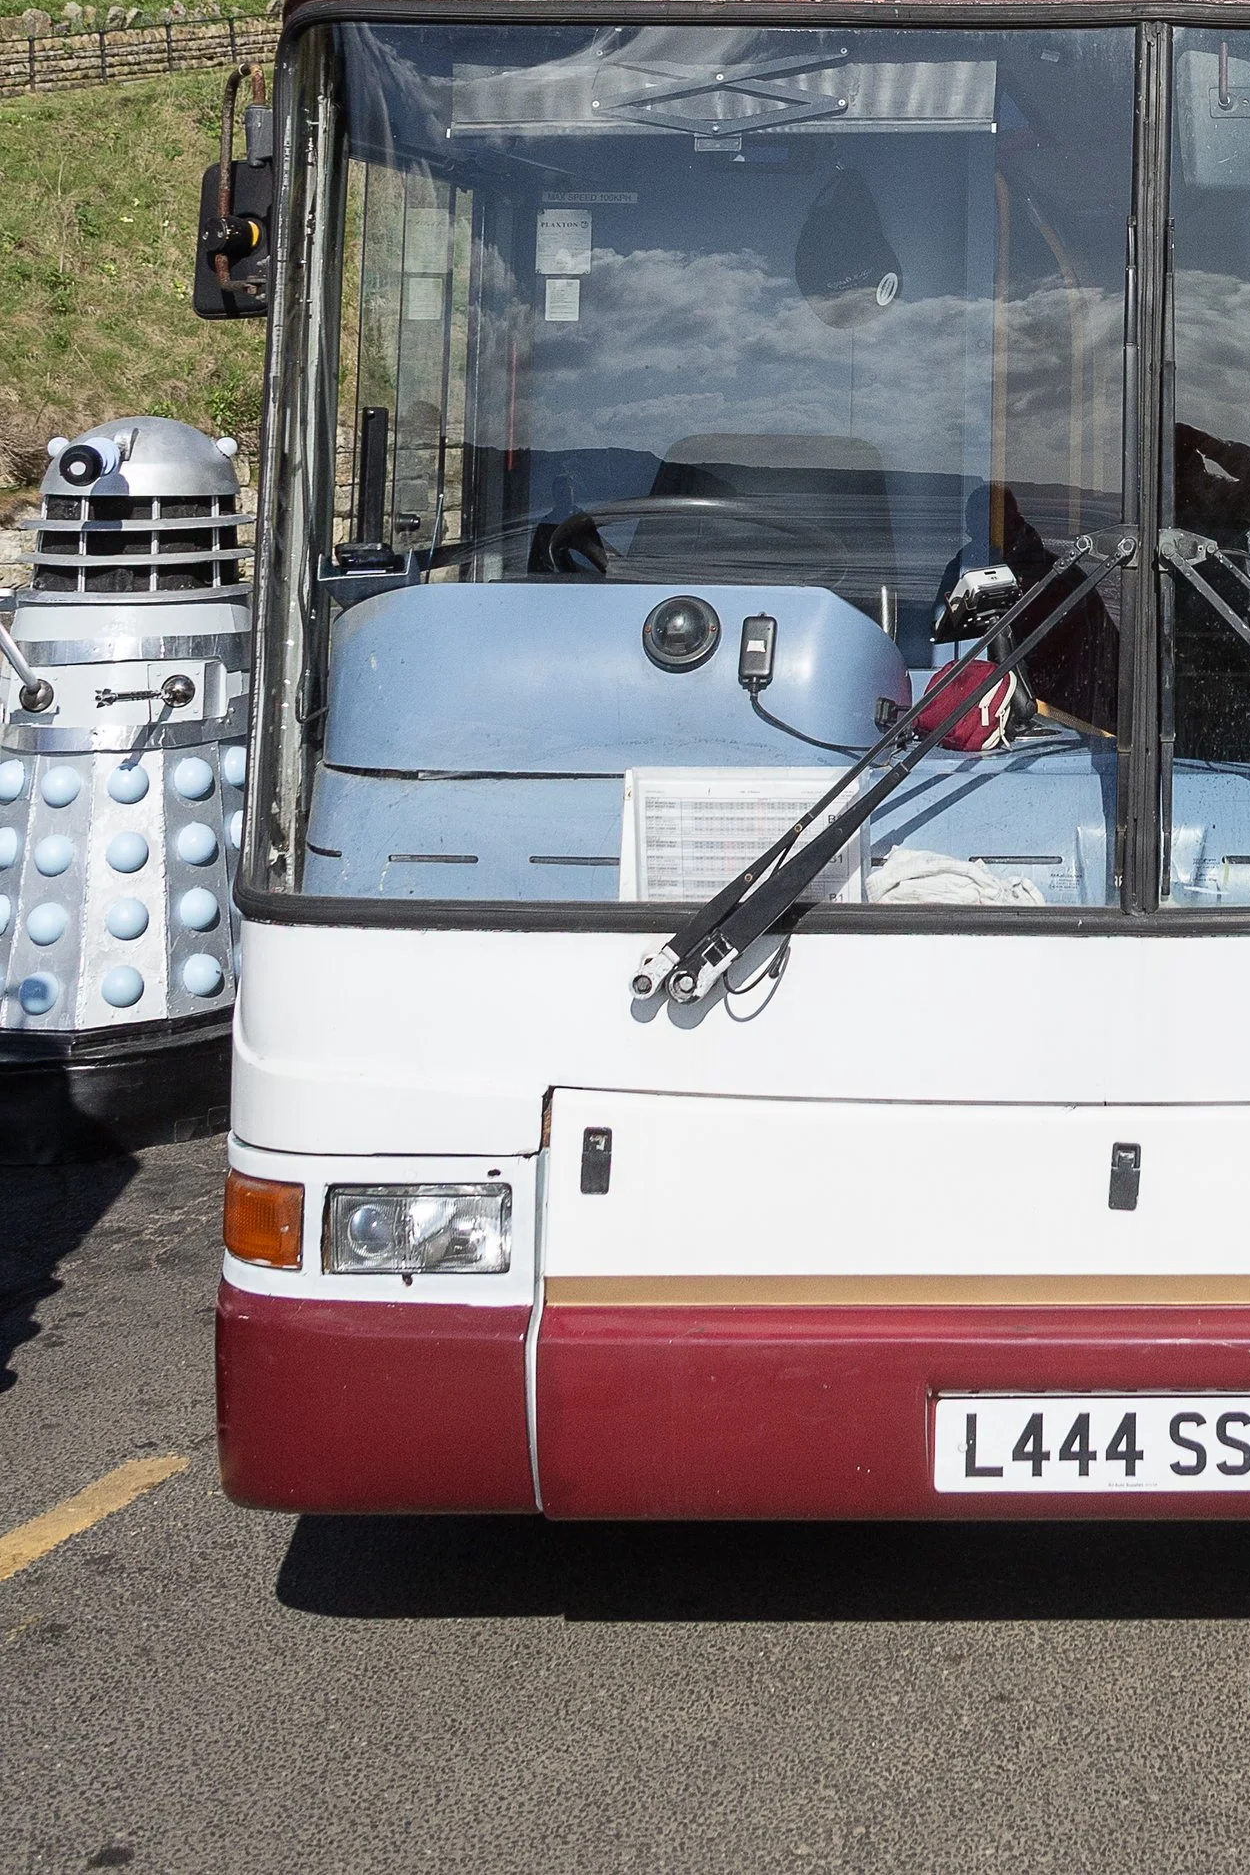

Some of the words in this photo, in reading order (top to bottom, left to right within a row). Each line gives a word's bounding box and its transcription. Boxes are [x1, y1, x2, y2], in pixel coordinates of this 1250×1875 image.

[567, 192, 597, 202] SPEED
[540, 221, 579, 229] PLAXTON
[965, 1412, 1144, 1477] L444
